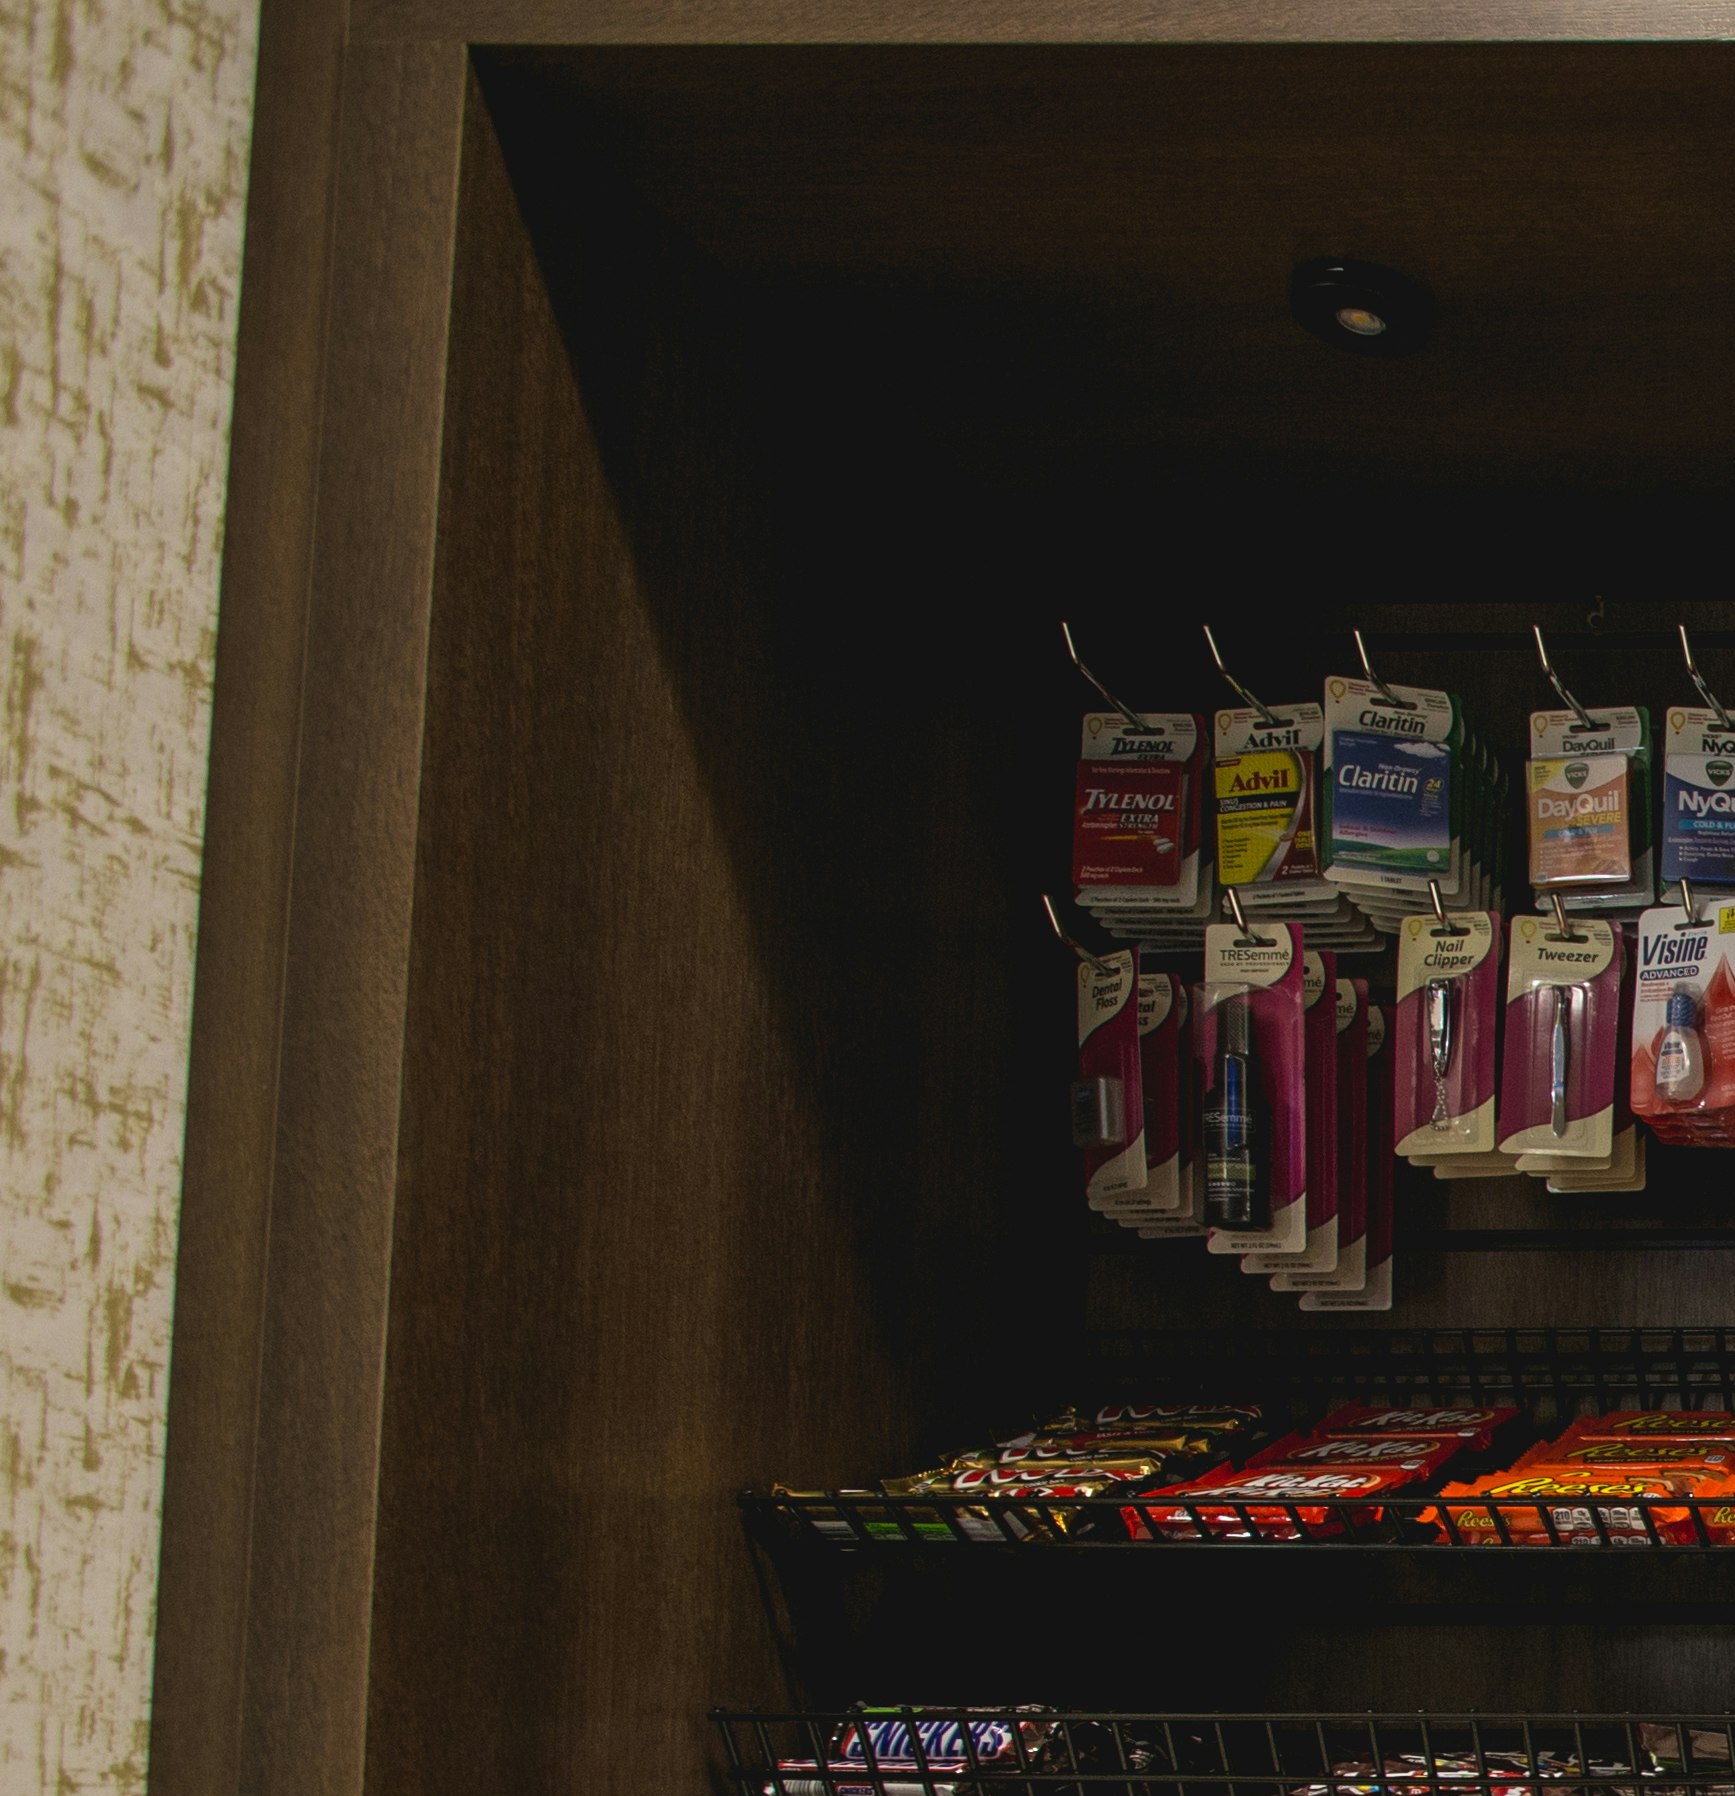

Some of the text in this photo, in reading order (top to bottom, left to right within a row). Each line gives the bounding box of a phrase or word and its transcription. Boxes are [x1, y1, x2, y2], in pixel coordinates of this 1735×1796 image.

[1359, 710, 1425, 735] Claritin
[1111, 737, 1174, 756] TYLENOL
[1244, 730, 1300, 749] Advil
[1563, 738, 1615, 753] DayQuil
[1229, 769, 1290, 793] Advil
[1338, 764, 1418, 794] Claritin
[1084, 788, 1175, 811] TYLENOL
[1538, 791, 1619, 820] DayQuil
[1120, 814, 1159, 823] EXTRA
[1577, 812, 1621, 825] SEVERE
[1220, 949, 1290, 961] TRESemmé
[1435, 940, 1464, 954] Nail
[1537, 947, 1599, 963] Tweezer
[1643, 935, 1708, 965] Visine
[1424, 952, 1474, 968] Clipper
[1642, 966, 1697, 979] ADVANCED
[1092, 979, 1123, 999] Dental
[1488, 1476, 1649, 1496] Reese's
